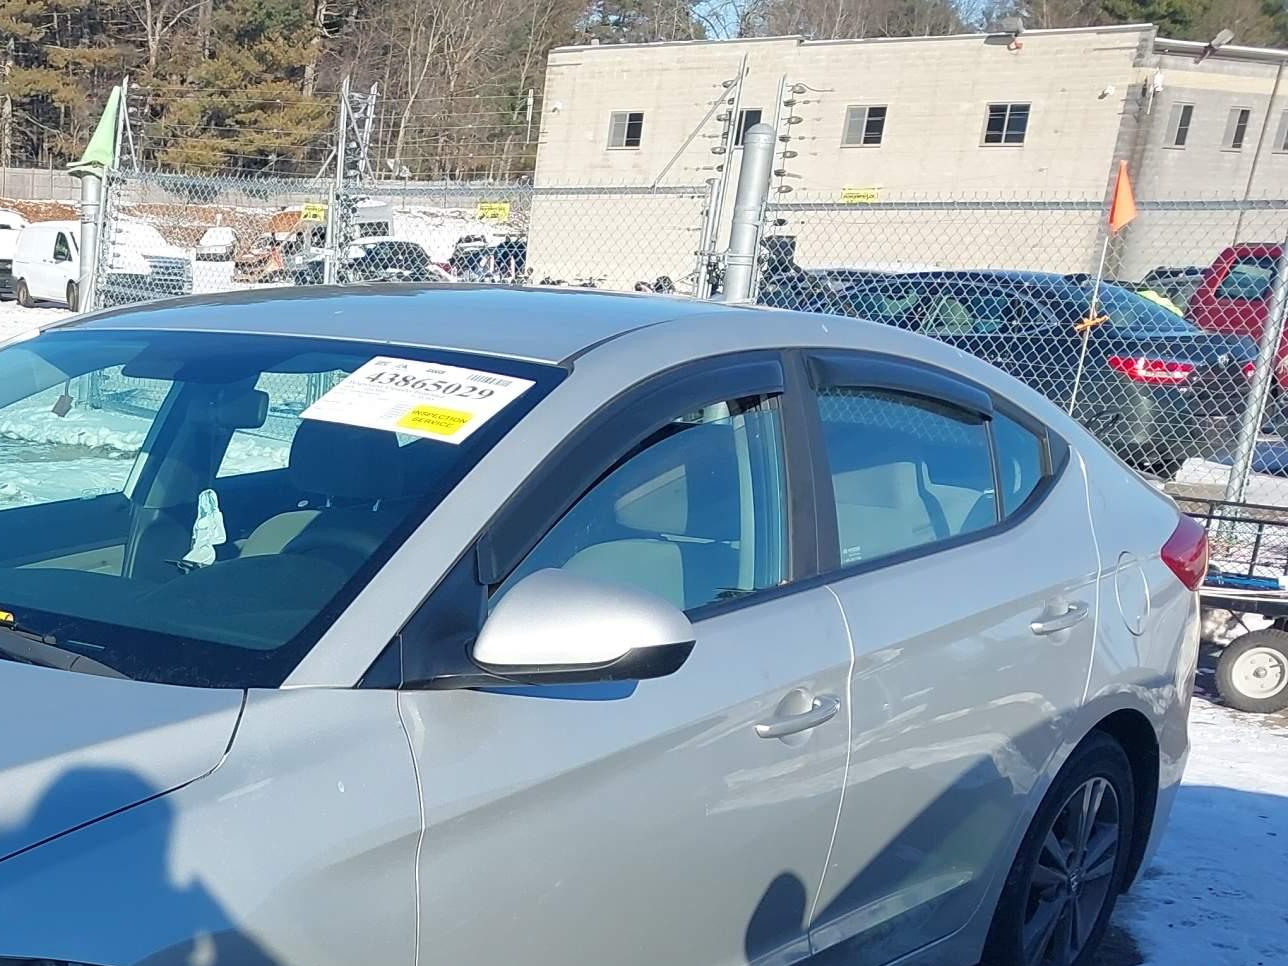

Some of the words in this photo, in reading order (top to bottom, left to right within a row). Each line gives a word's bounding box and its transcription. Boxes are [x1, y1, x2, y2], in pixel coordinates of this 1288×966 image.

[366, 371, 495, 400] 43865029
[411, 417, 455, 429] SERVICE
[412, 409, 468, 425] INSPECTION
